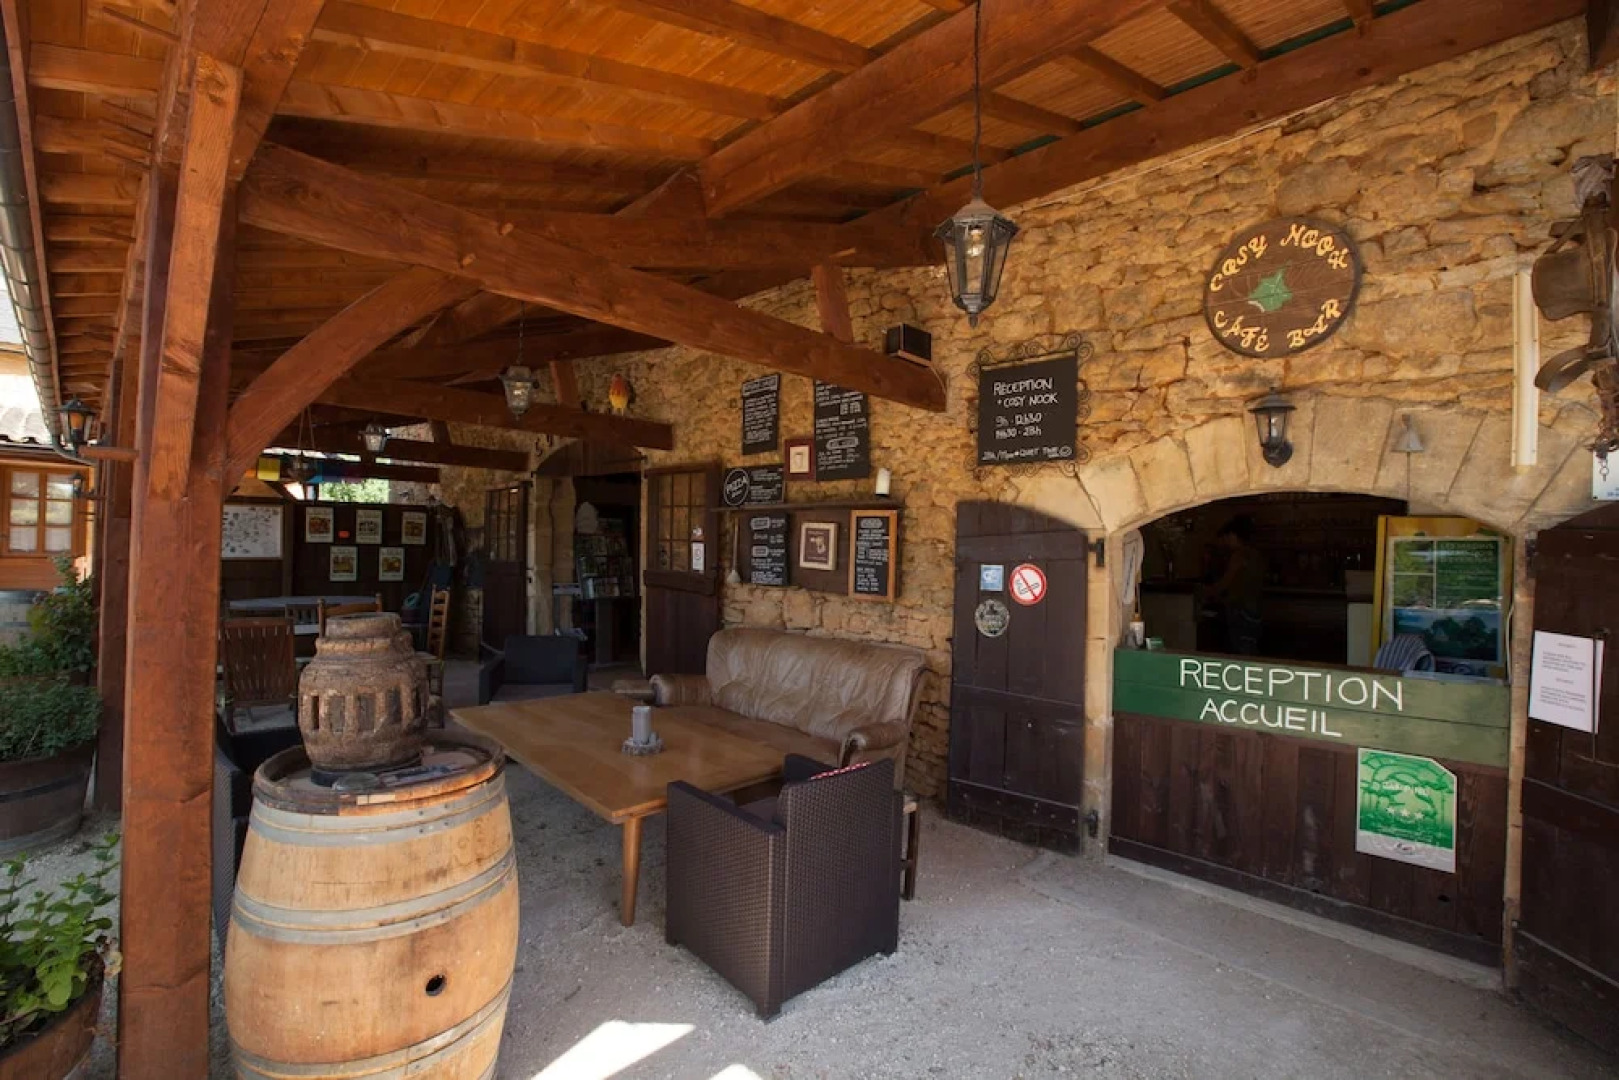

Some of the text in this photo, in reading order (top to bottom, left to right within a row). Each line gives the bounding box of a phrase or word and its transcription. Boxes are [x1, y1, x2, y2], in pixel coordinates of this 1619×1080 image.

[1280, 223, 1349, 270] NOOK
[1214, 299, 1342, 352] CAFÉ BAR
[993, 377, 1054, 395] RECEPTION
[1003, 394, 1026, 408] COSY
[1030, 392, 1059, 406] NOOK
[1180, 658, 1403, 711] RECEPTION
[1199, 698, 1342, 738] ACCUEIL
